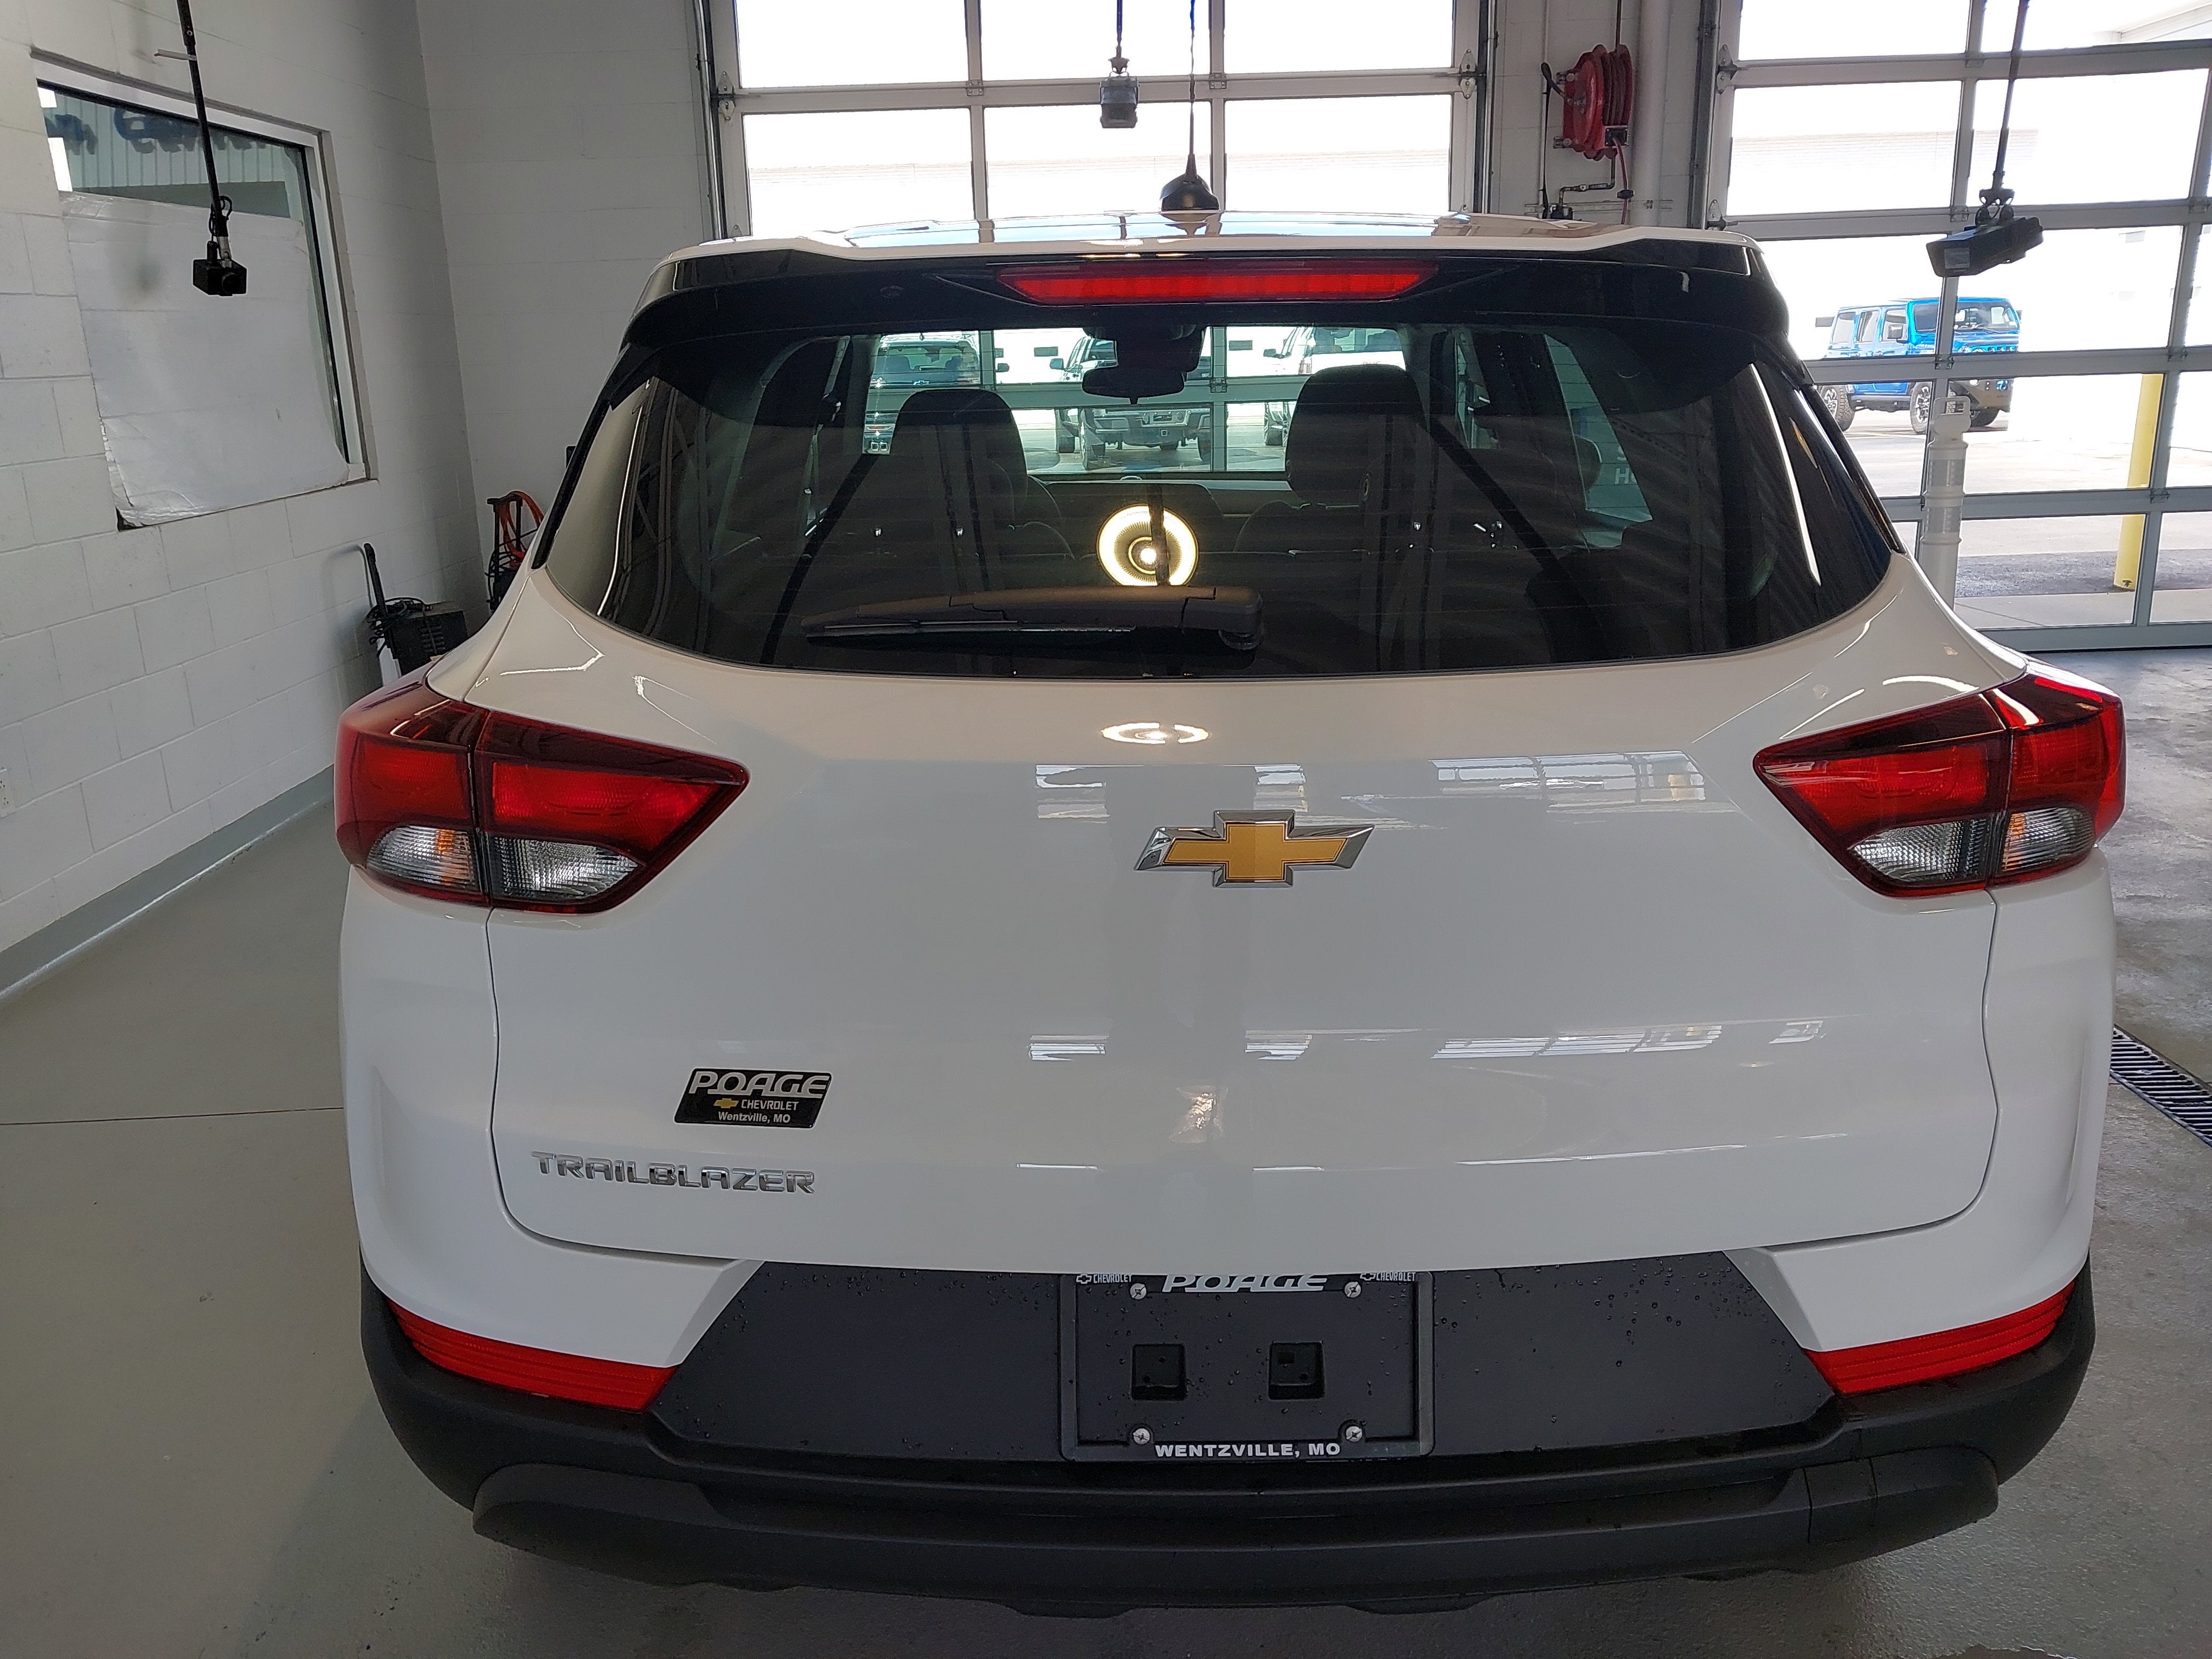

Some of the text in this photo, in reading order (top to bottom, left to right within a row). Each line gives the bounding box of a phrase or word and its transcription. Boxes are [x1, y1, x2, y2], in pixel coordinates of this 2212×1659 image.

[688, 1071, 830, 1099] POAGE
[741, 1099, 799, 1111] CHEVROLET
[718, 1111, 791, 1124] Wentzville, MO
[531, 1150, 815, 1193] TRAILBLAZER
[1093, 1274, 1132, 1284] CHEVROLET
[1376, 1271, 1416, 1282] CHEVROLET
[1155, 1443, 1340, 1458] WENTZVILLE, MO
